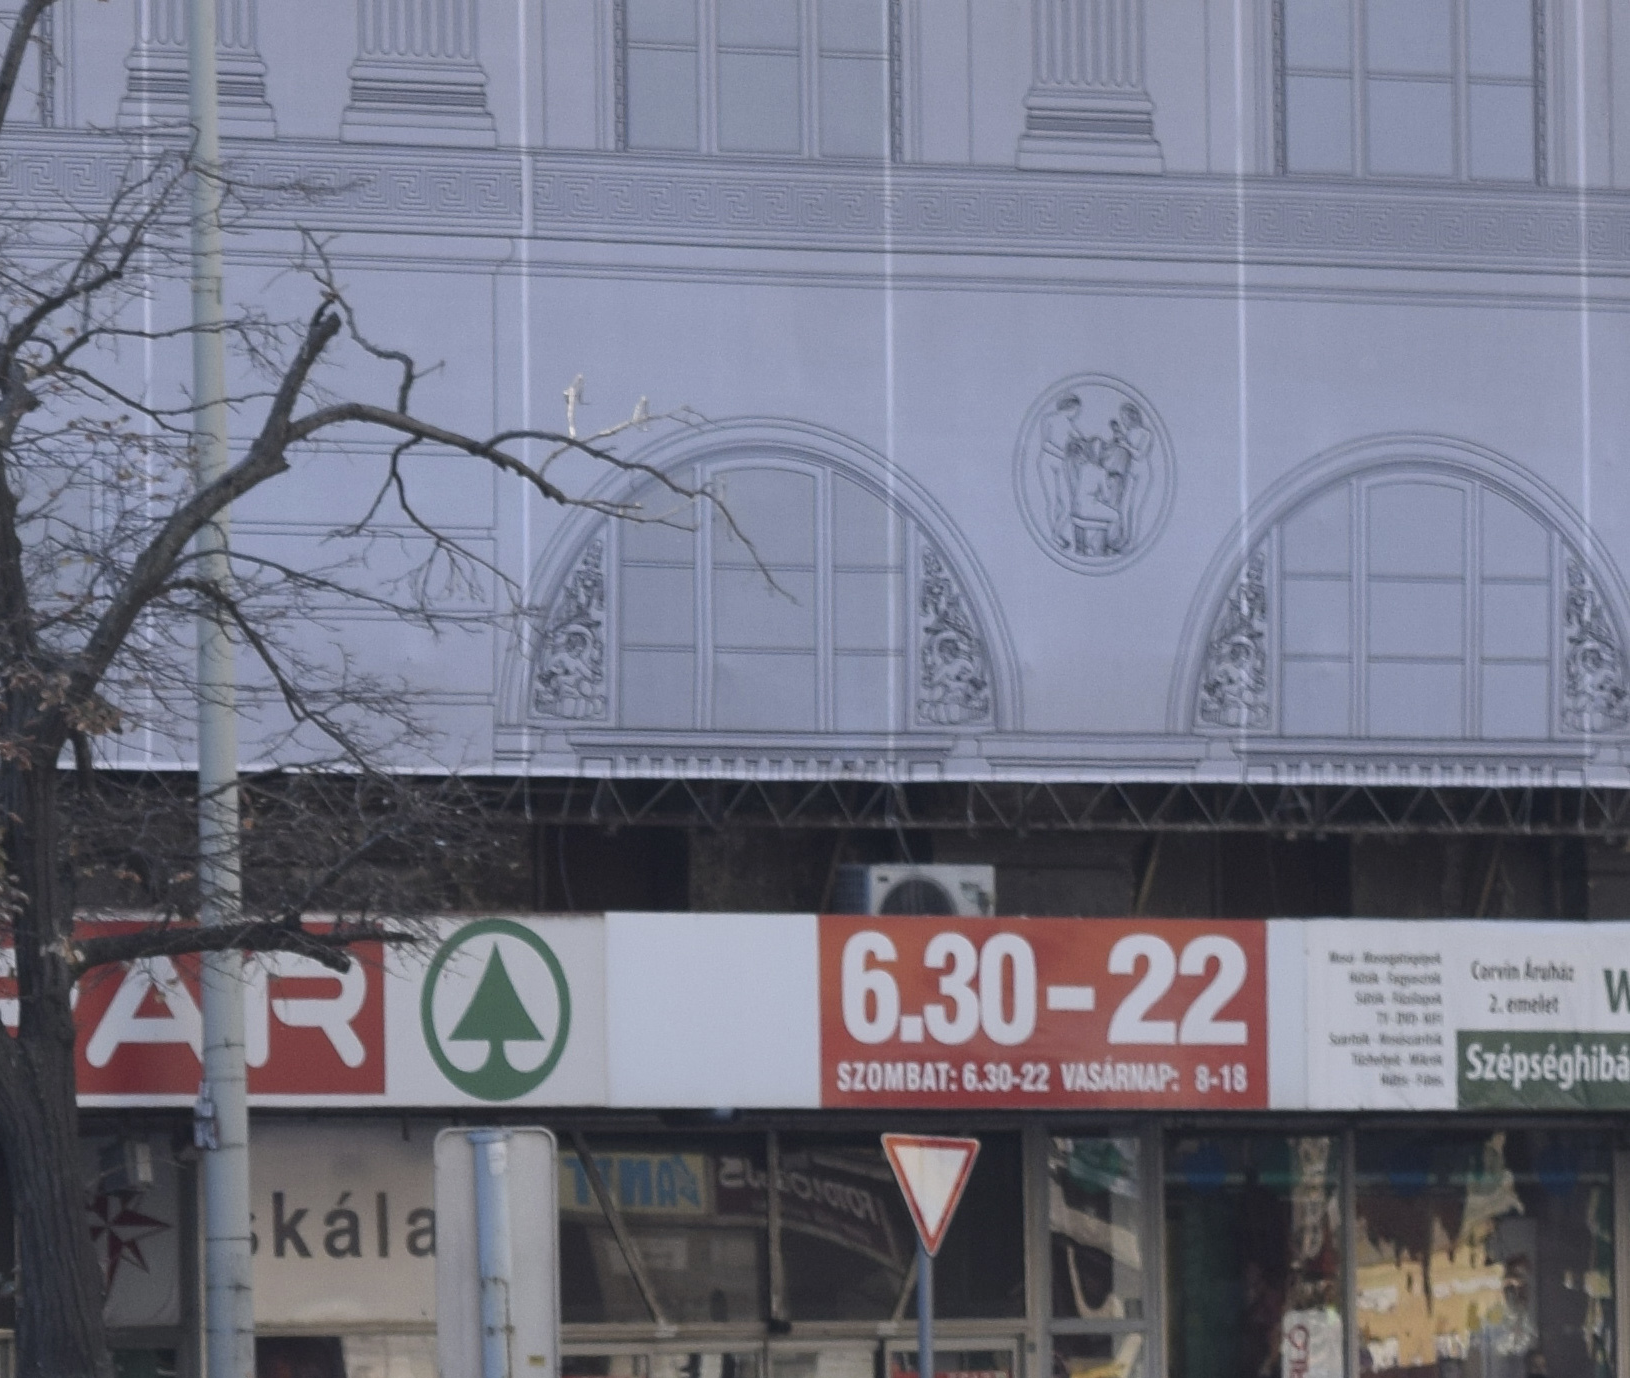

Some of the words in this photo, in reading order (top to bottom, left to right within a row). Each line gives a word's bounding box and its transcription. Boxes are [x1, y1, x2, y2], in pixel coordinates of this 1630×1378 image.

[1470, 961, 1521, 982] Corvin
[1525, 957, 1575, 982] Áruház
[1506, 993, 1559, 1014] emelet
[838, 1062, 958, 1092] SZOMBAT:
[962, 1062, 1050, 1092] 6.30-22
[1060, 1056, 1180, 1092] VASÁRNAP:
[1194, 1063, 1248, 1092] 8-18
[250, 1191, 437, 1258] kála
